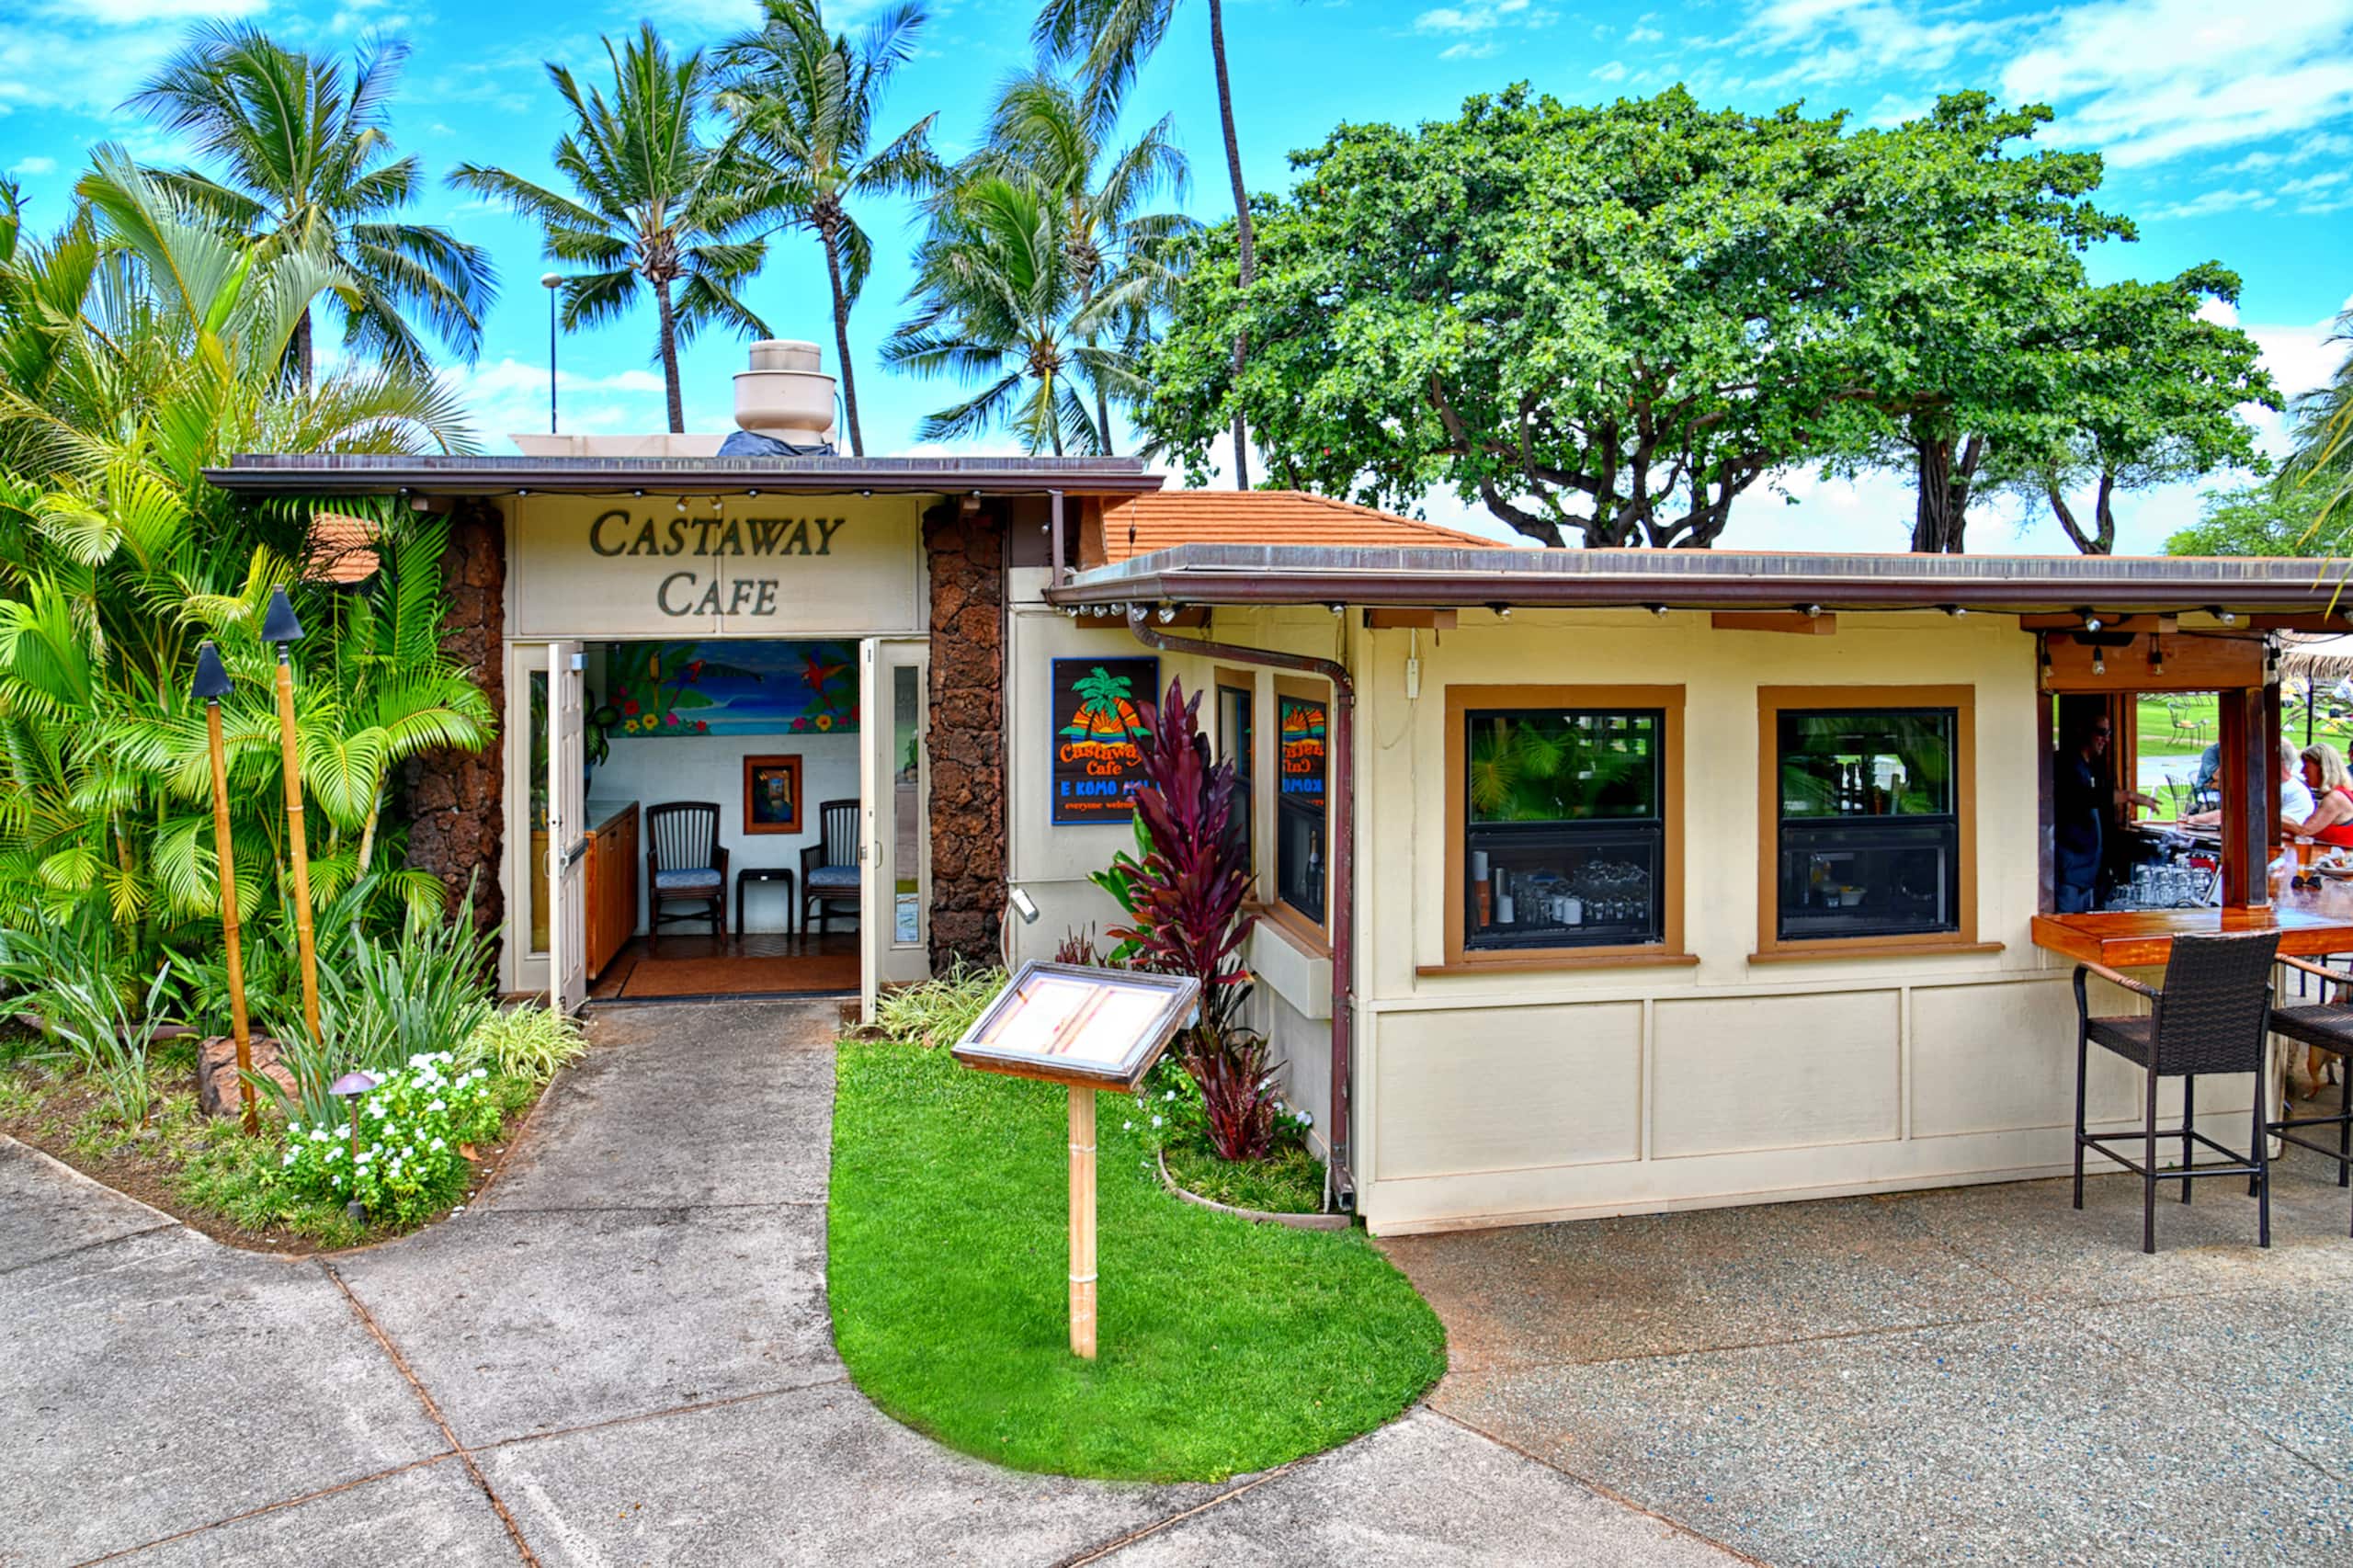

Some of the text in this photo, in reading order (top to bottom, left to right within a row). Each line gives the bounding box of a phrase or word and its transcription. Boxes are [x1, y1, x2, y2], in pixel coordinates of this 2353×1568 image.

[589, 509, 846, 557] CASTAWAY
[656, 571, 780, 618] CAFE
[1086, 760, 1122, 776] Cafe
[1060, 779, 1071, 797] E
[1075, 779, 1118, 796] KOMO
